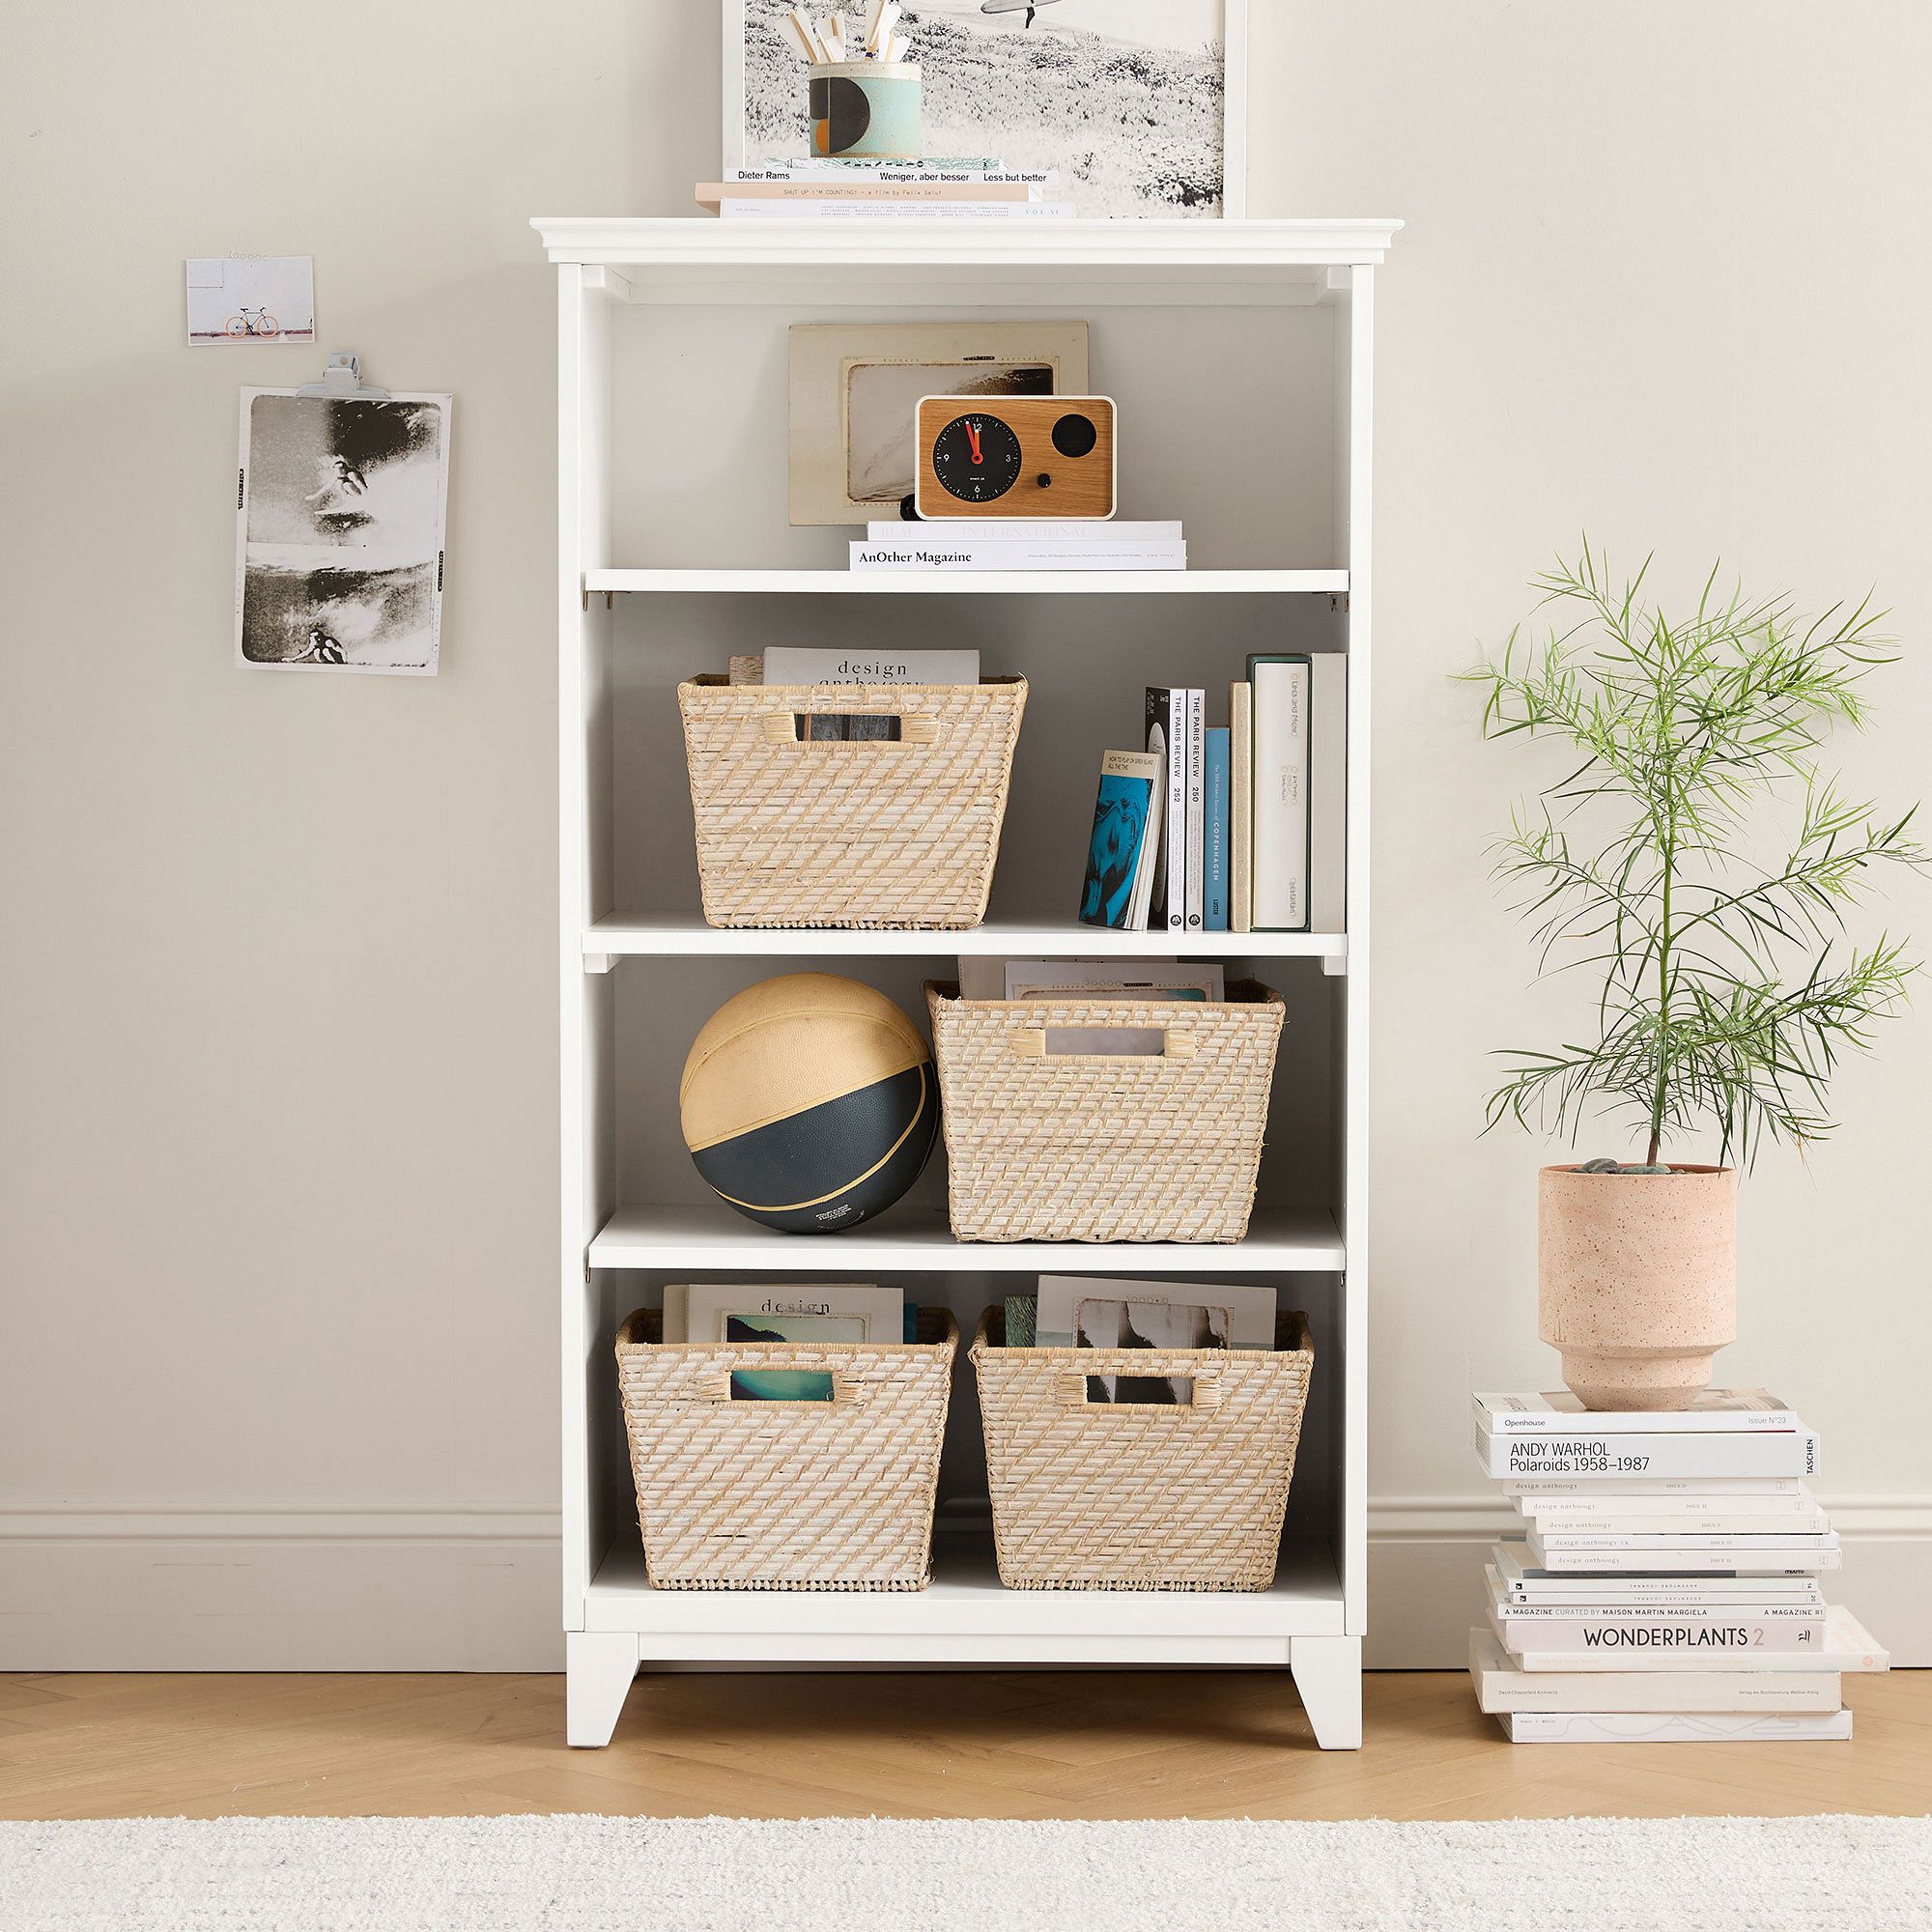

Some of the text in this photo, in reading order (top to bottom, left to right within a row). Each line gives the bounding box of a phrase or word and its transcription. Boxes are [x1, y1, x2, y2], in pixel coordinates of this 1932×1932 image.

[738, 170, 790, 180] Dieter Rams
[879, 171, 970, 183] Weniger, aber besser
[983, 173, 1047, 183] Less but better
[973, 423, 982, 432] 12
[961, 526, 1090, 537] INTERNATIONAL
[859, 551, 972, 566] AnOther Magazine
[838, 661, 906, 679] design
[761, 1298, 830, 1315] design
[1510, 1442, 1610, 1456] ANDY WARHOL
[1510, 1457, 1571, 1471] Polaroids
[1583, 1628, 1764, 1646] WONDERPLANTS 2
